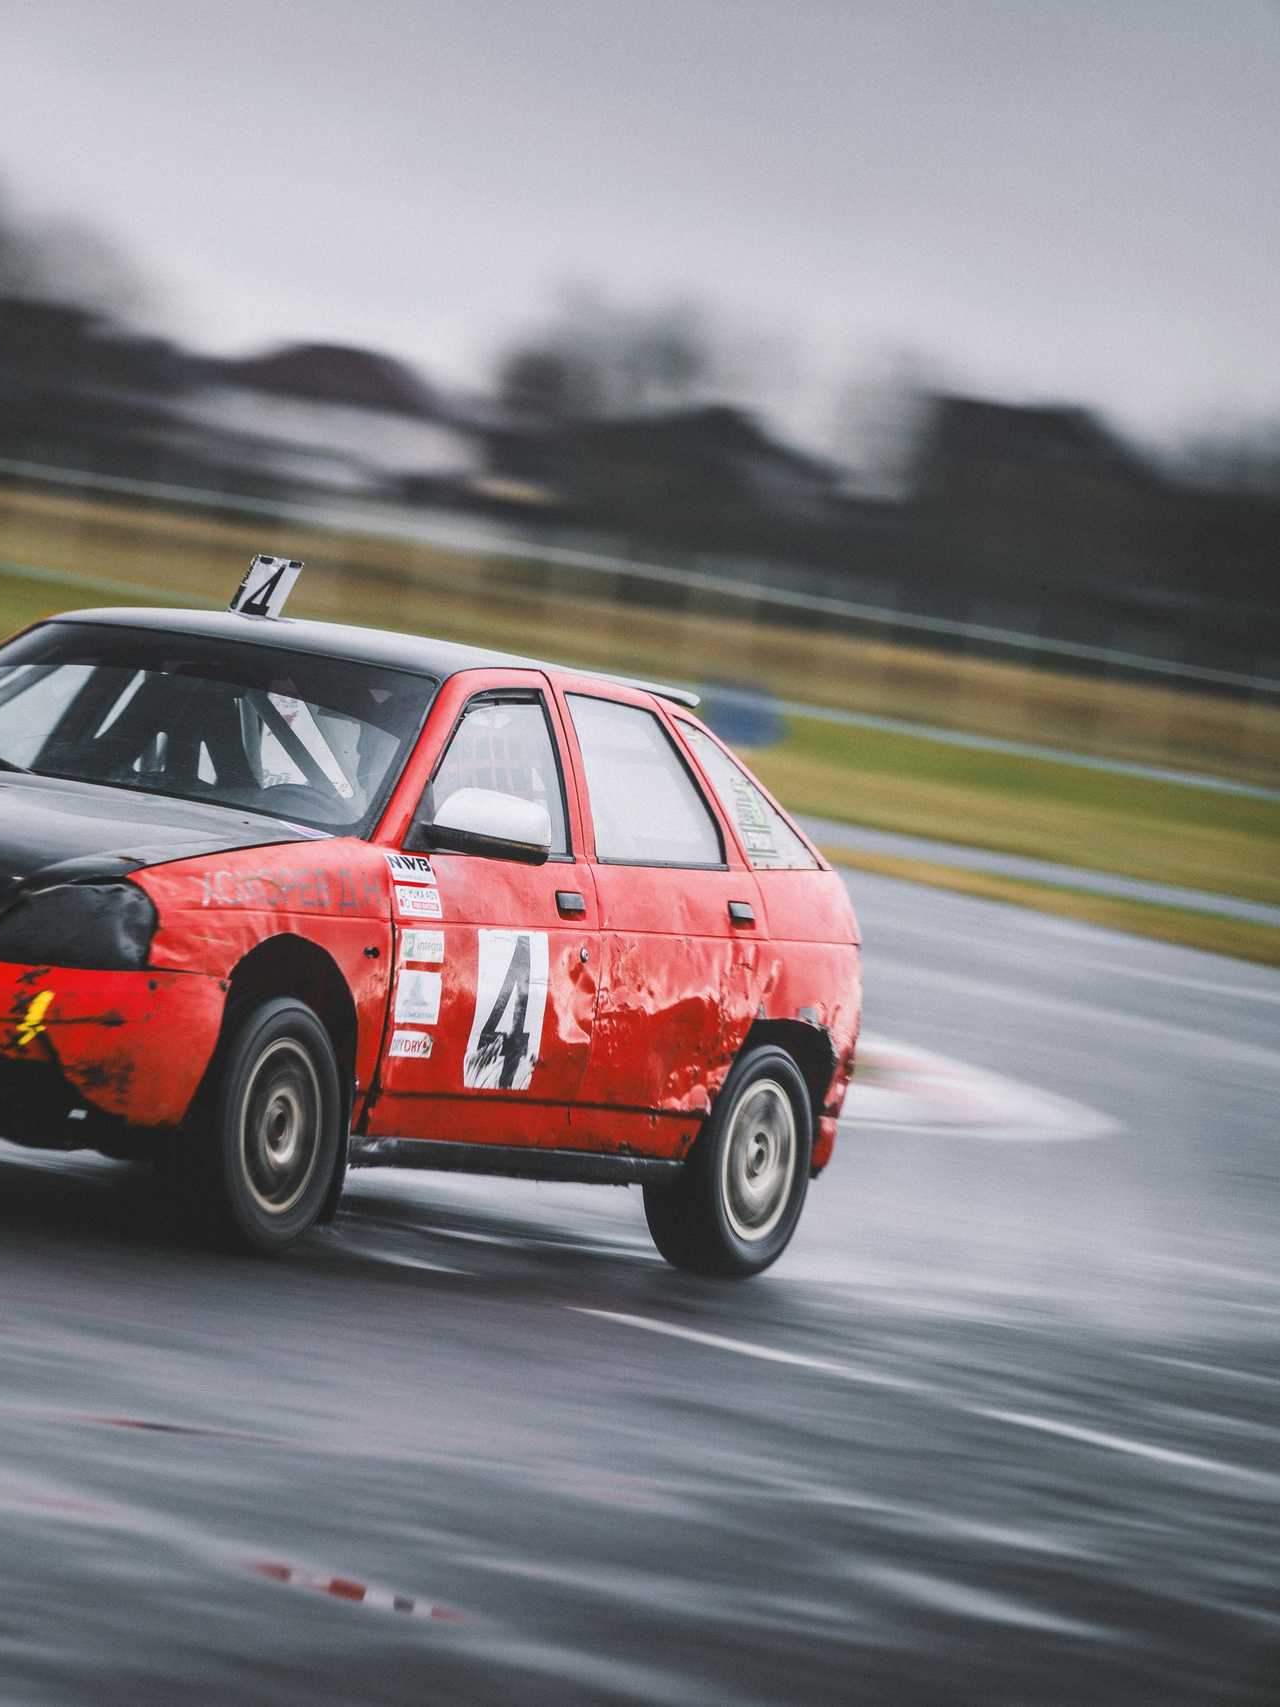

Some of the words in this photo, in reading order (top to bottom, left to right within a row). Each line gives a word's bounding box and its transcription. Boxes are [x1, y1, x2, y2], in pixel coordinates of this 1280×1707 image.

[239, 564, 287, 617] 4
[386, 855, 431, 872] NWB
[417, 939, 443, 954] integra
[477, 935, 531, 1089] 4
